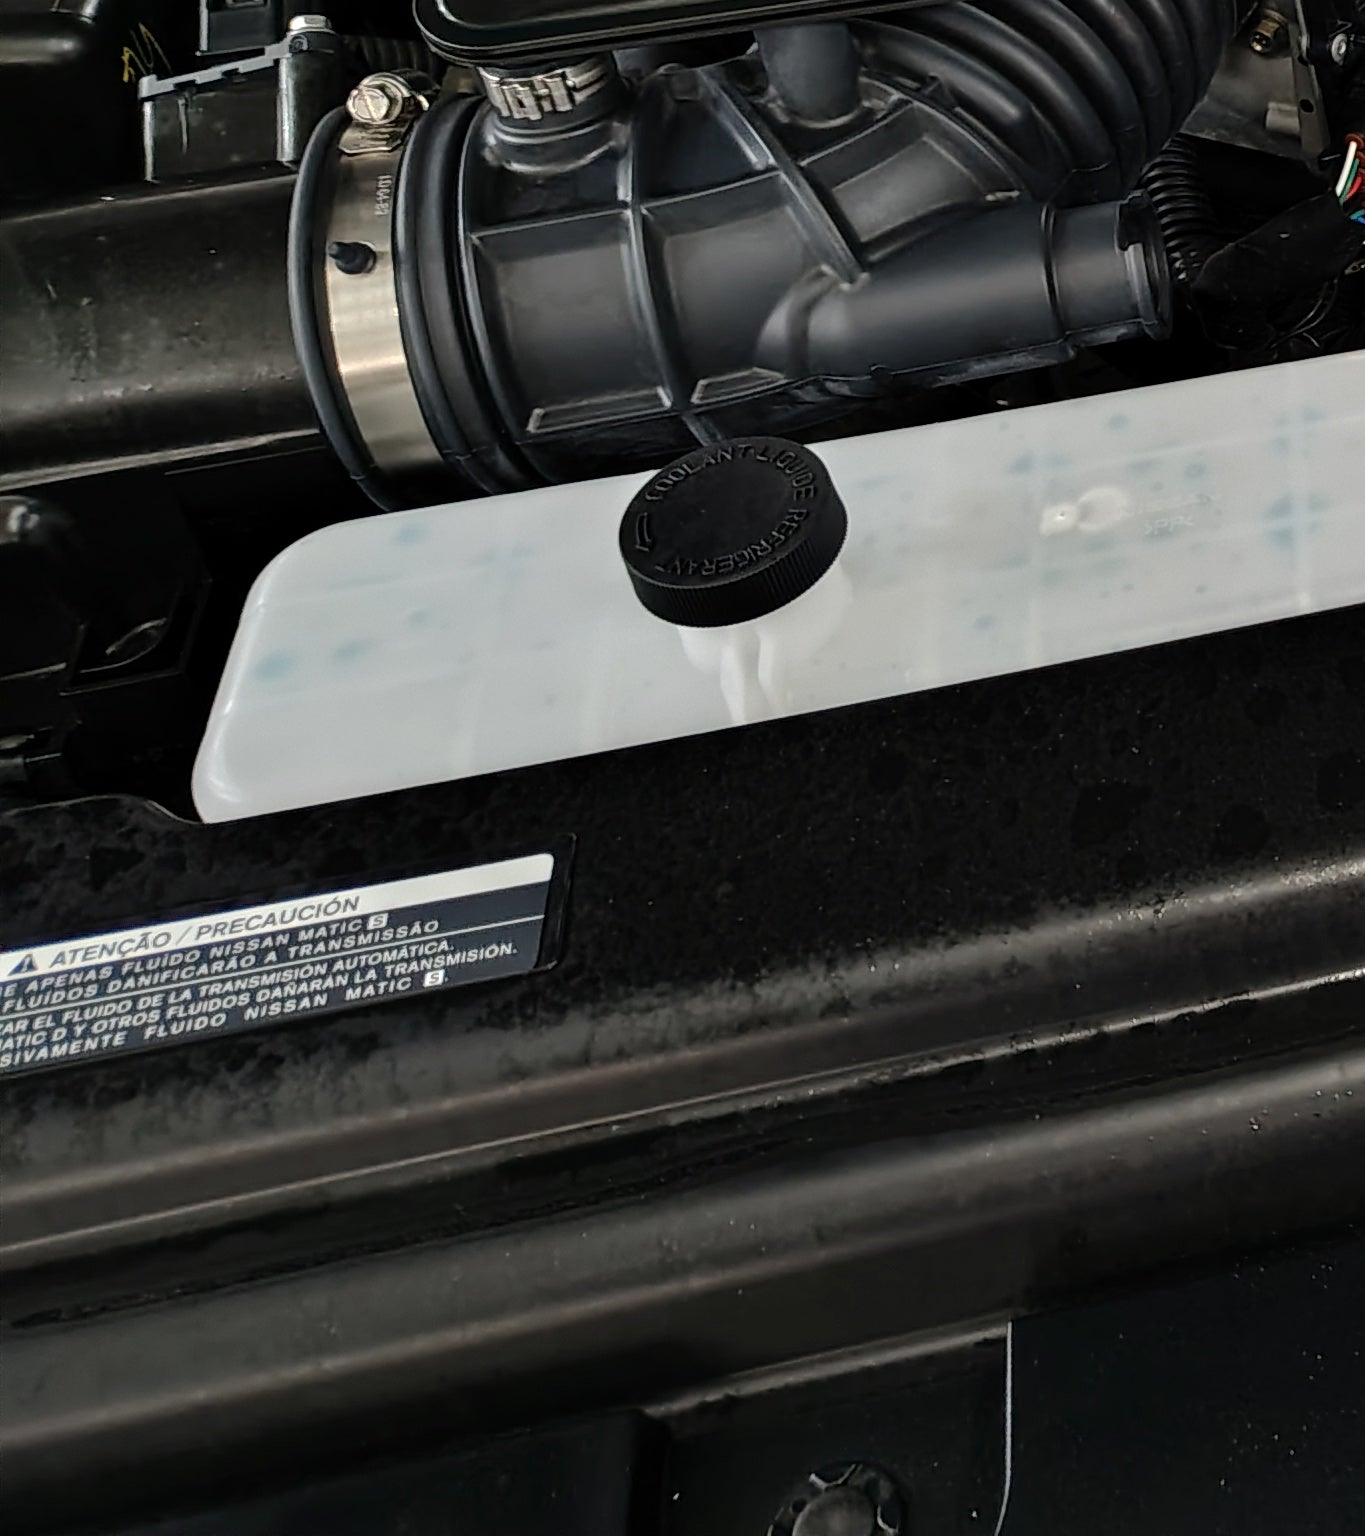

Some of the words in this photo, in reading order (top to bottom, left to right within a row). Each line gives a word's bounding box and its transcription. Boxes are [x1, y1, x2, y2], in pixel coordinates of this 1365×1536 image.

[645, 443, 754, 502] COOLANT
[24, 966, 113, 994] APENAS
[209, 933, 290, 959] NISSAN
[298, 919, 363, 942] MATIC
[50, 931, 172, 969] ATENÇÃO
[194, 896, 360, 941] PRECAUCIÓN
[106, 955, 256, 994] DANIFICARÃO
[264, 951, 278, 964] A
[288, 920, 439, 959] TRANSMISSÃO
[31, 1014, 55, 1030] EL
[61, 999, 133, 1025] FLUIDO
[137, 993, 165, 1009] DE
[167, 987, 192, 1004] LA
[199, 961, 328, 997] TRANSMISIÓN
[332, 938, 455, 972] AUTOMÁTICA.
[52, 1027, 67, 1041] D
[73, 1023, 88, 1037] Y
[90, 1010, 157, 1035] OTROS
[165, 992, 250, 1018] FLUIDOS
[256, 972, 350, 1002] DAÑARÁN
[354, 969, 377, 984] LA
[385, 942, 518, 977] TRANSMISIÓN.
[143, 1013, 227, 1040] FLUIDO
[244, 993, 328, 1021] NISSAN
[345, 976, 412, 1001] MATIC
